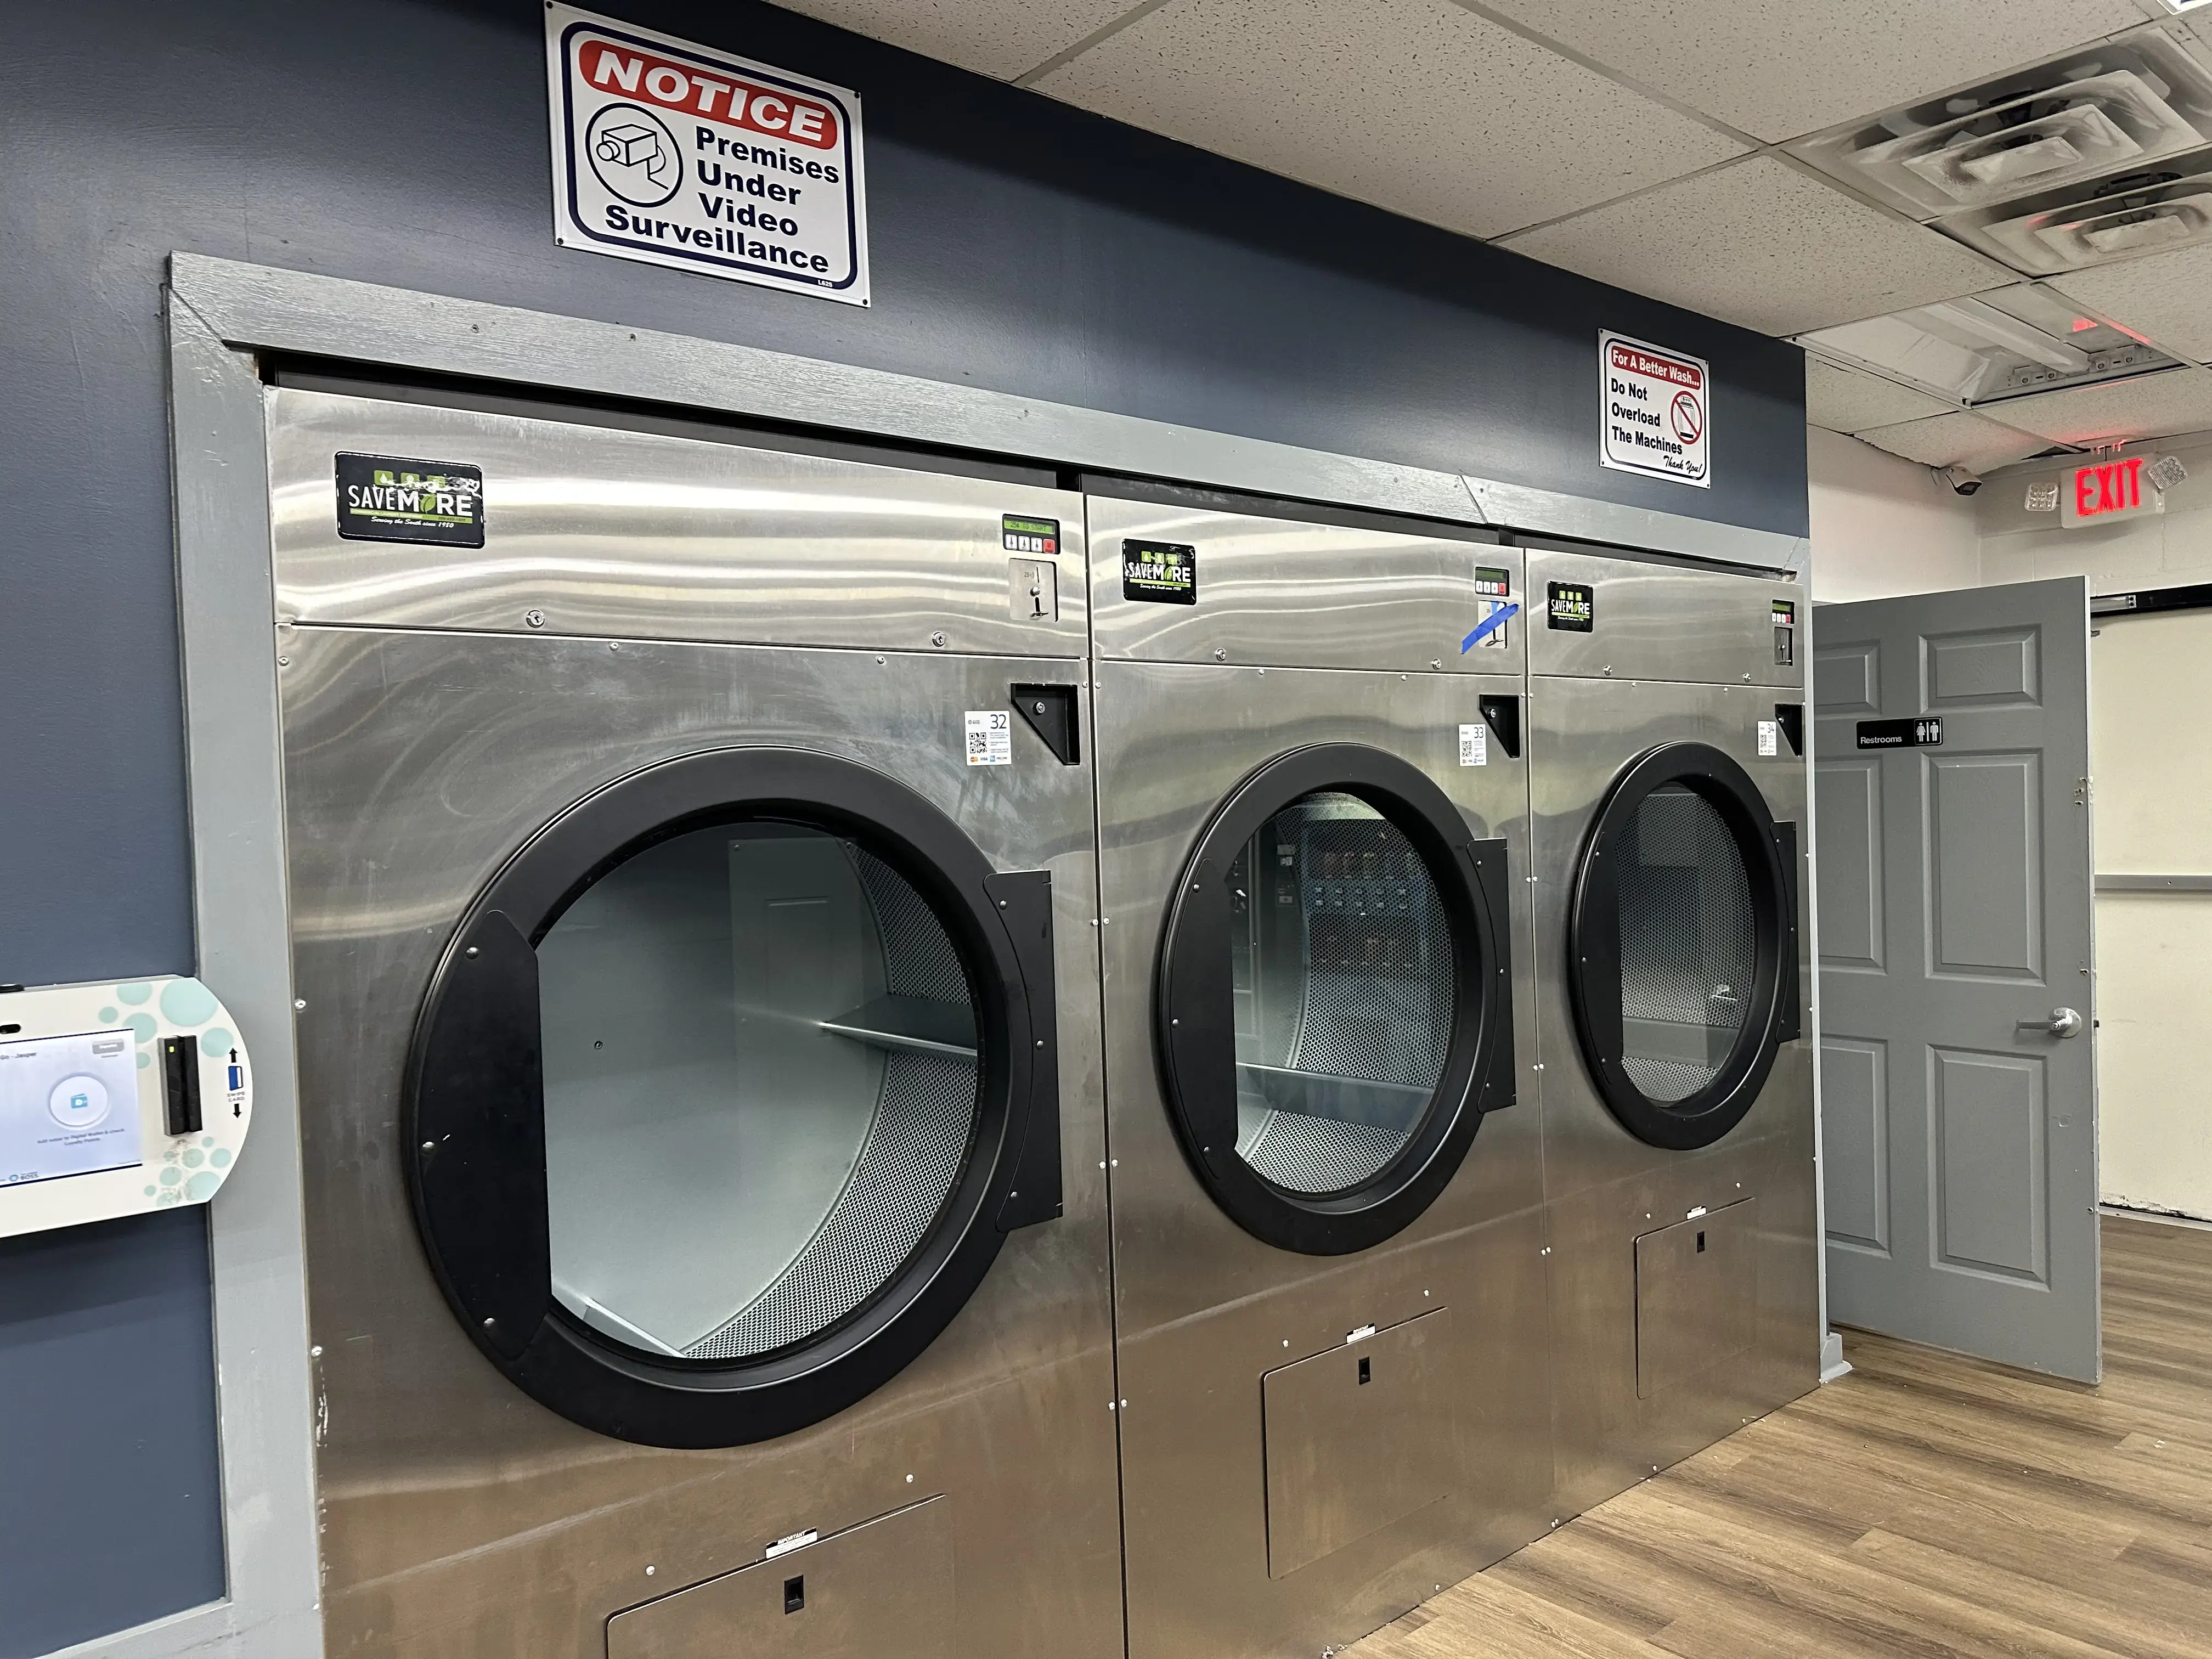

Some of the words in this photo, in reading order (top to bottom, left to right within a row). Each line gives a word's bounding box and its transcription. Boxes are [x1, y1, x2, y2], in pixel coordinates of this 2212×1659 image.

[593, 50, 825, 142] NOTICE
[696, 126, 839, 184] Premises
[697, 159, 802, 205] Under
[698, 192, 798, 236] Video
[605, 205, 829, 273] Surveillance
[1612, 349, 1628, 366] For
[1630, 355, 1637, 369] A
[1639, 357, 1667, 377] Better
[1669, 365, 1699, 387] Wash...
[1611, 377, 1624, 394] Do
[1629, 382, 1647, 400] Not
[1612, 402, 1660, 427] Overload
[1612, 426, 1632, 443] The
[1635, 431, 1682, 455] Machines
[1663, 455, 1684, 470] Thank
[1685, 460, 1703, 474] You!
[2076, 458, 2142, 517] EXIT
[371, 516, 393, 524] Serving
[990, 714, 1007, 729] 32
[1474, 727, 1484, 738] 33
[1768, 723, 1775, 733] 34
[777, 1530, 805, 1544] IMPORTANT
